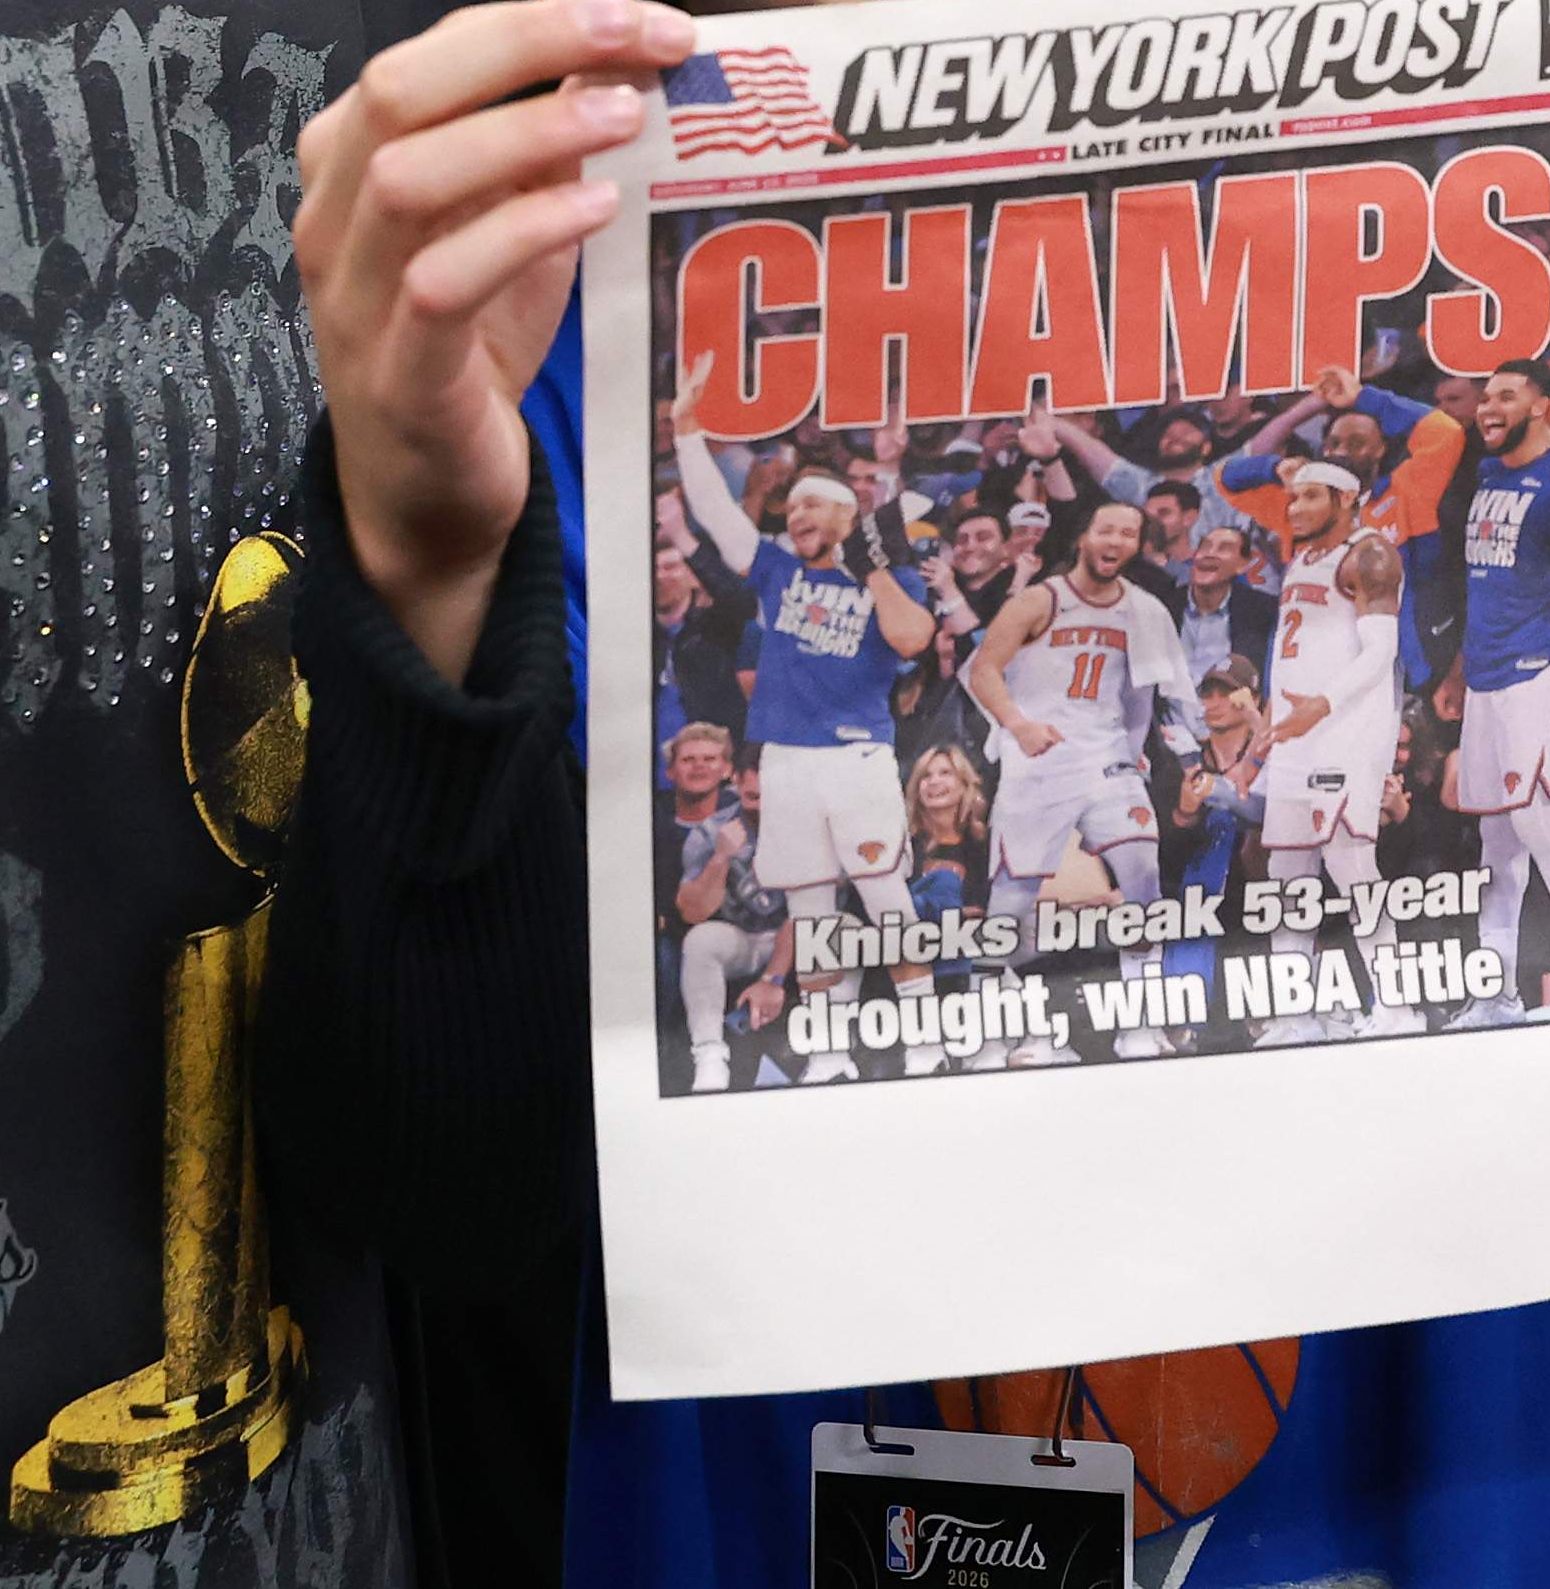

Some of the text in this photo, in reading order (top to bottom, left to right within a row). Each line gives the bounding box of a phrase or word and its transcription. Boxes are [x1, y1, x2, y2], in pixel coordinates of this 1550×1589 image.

[833, 31, 1055, 151] NEW
[1049, 5, 1295, 135] YORK
[1072, 122, 1274, 160] LATE CITY FINAL
[1281, 609, 1303, 659] 2
[1066, 652, 1106, 700] 11
[794, 864, 1491, 974] Knicks break 53-year
[786, 936, 1505, 1057] drought, win NBA title
[901, 1513, 1047, 1580] Finals
[947, 1567, 991, 1589] 2026
